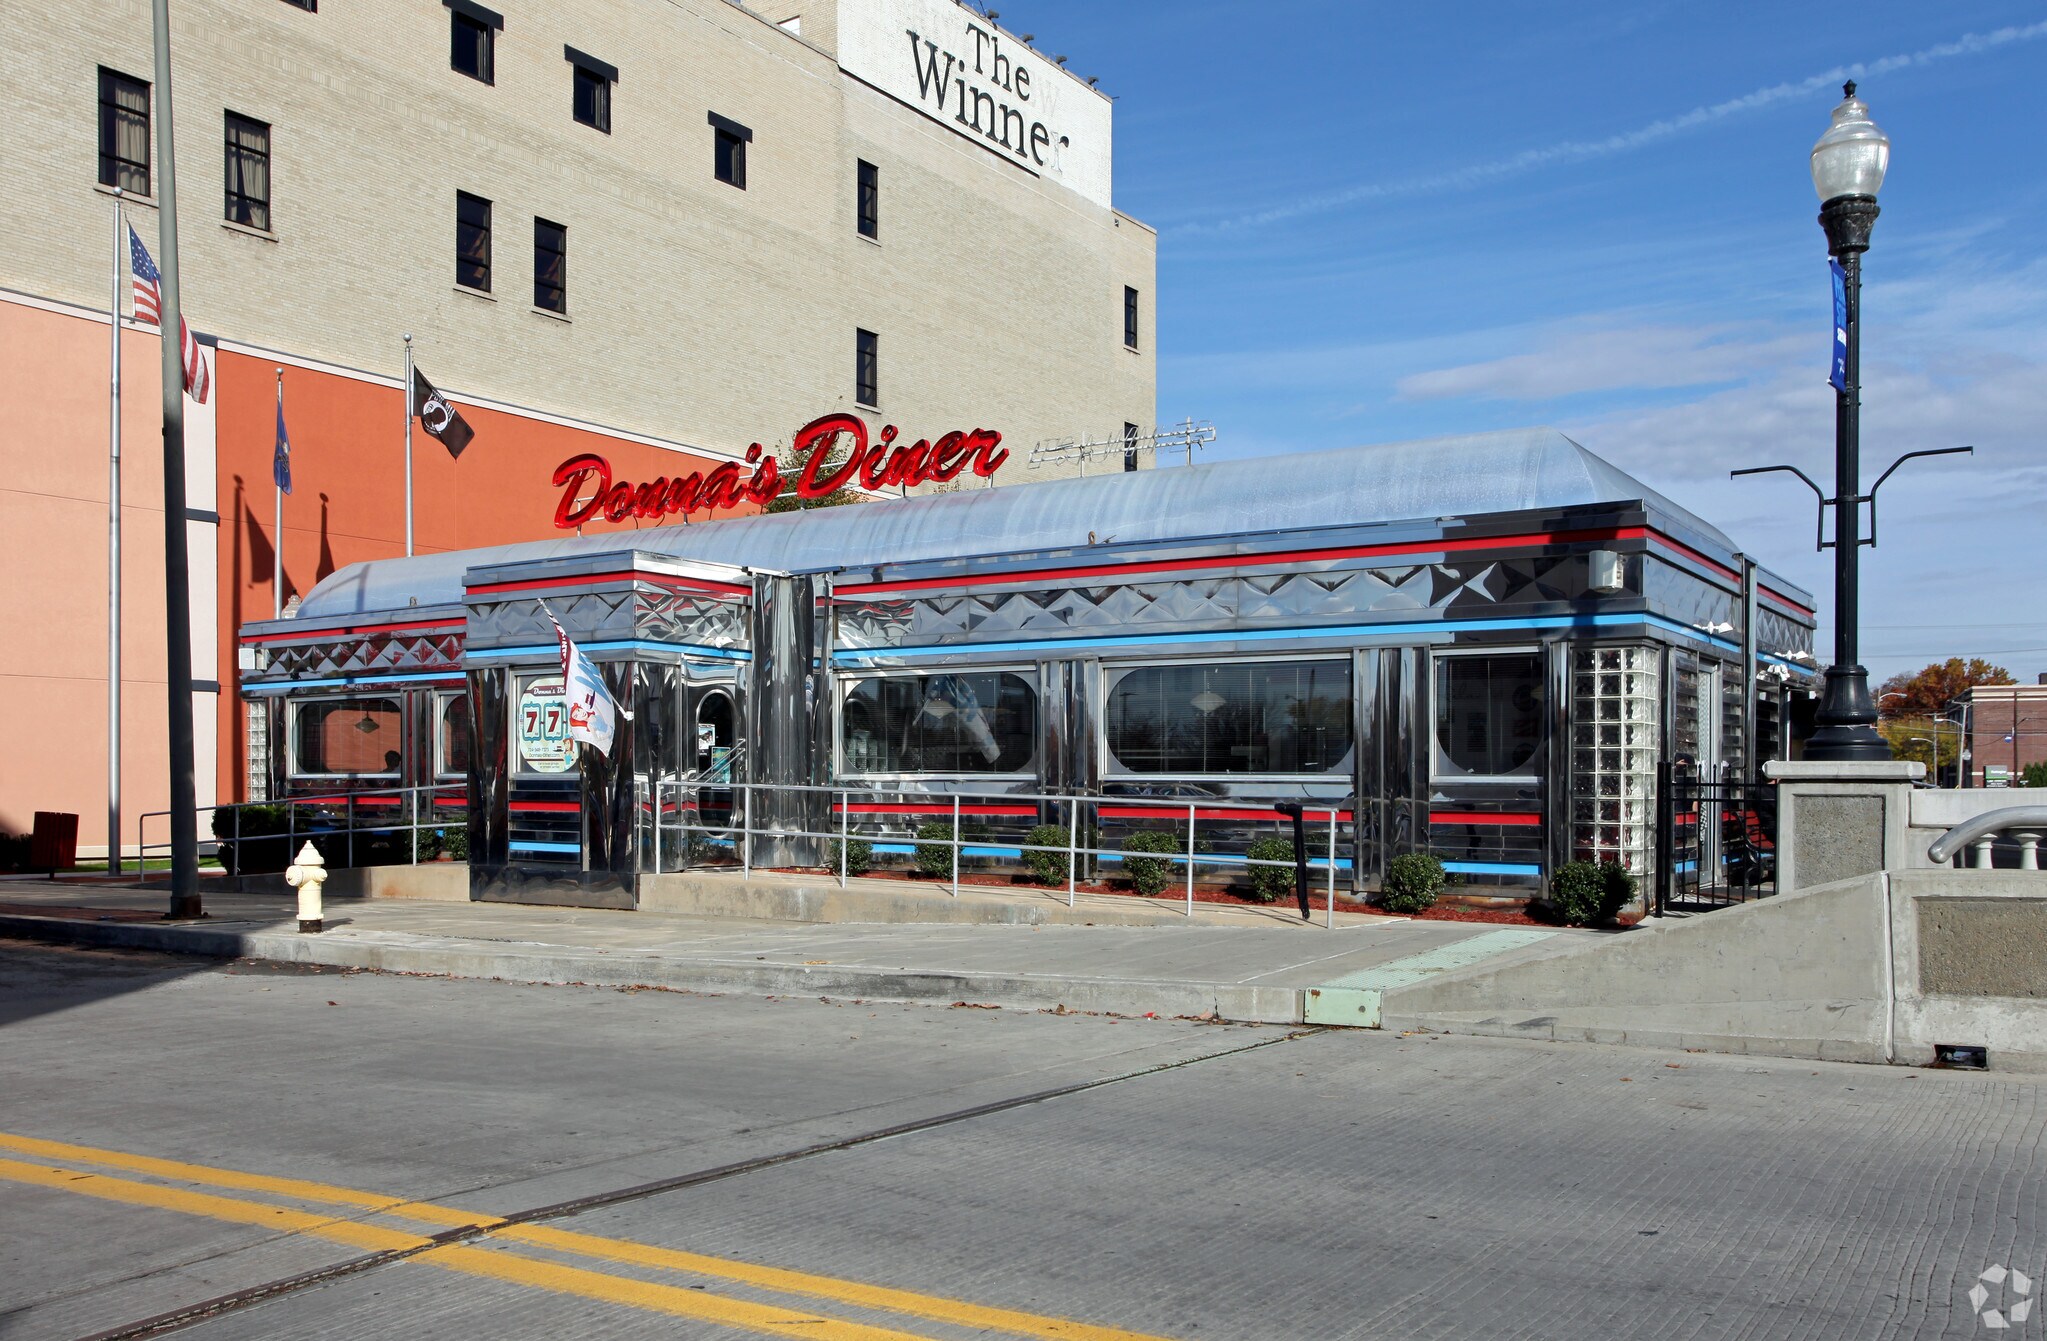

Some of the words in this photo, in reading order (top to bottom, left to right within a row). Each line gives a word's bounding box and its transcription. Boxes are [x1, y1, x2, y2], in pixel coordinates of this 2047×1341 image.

[966, 22, 1030, 101] The
[553, 443, 787, 529] Donna's
[794, 412, 1010, 500] Diner
[526, 711, 538, 733] 7
[547, 710, 560, 733] 7
